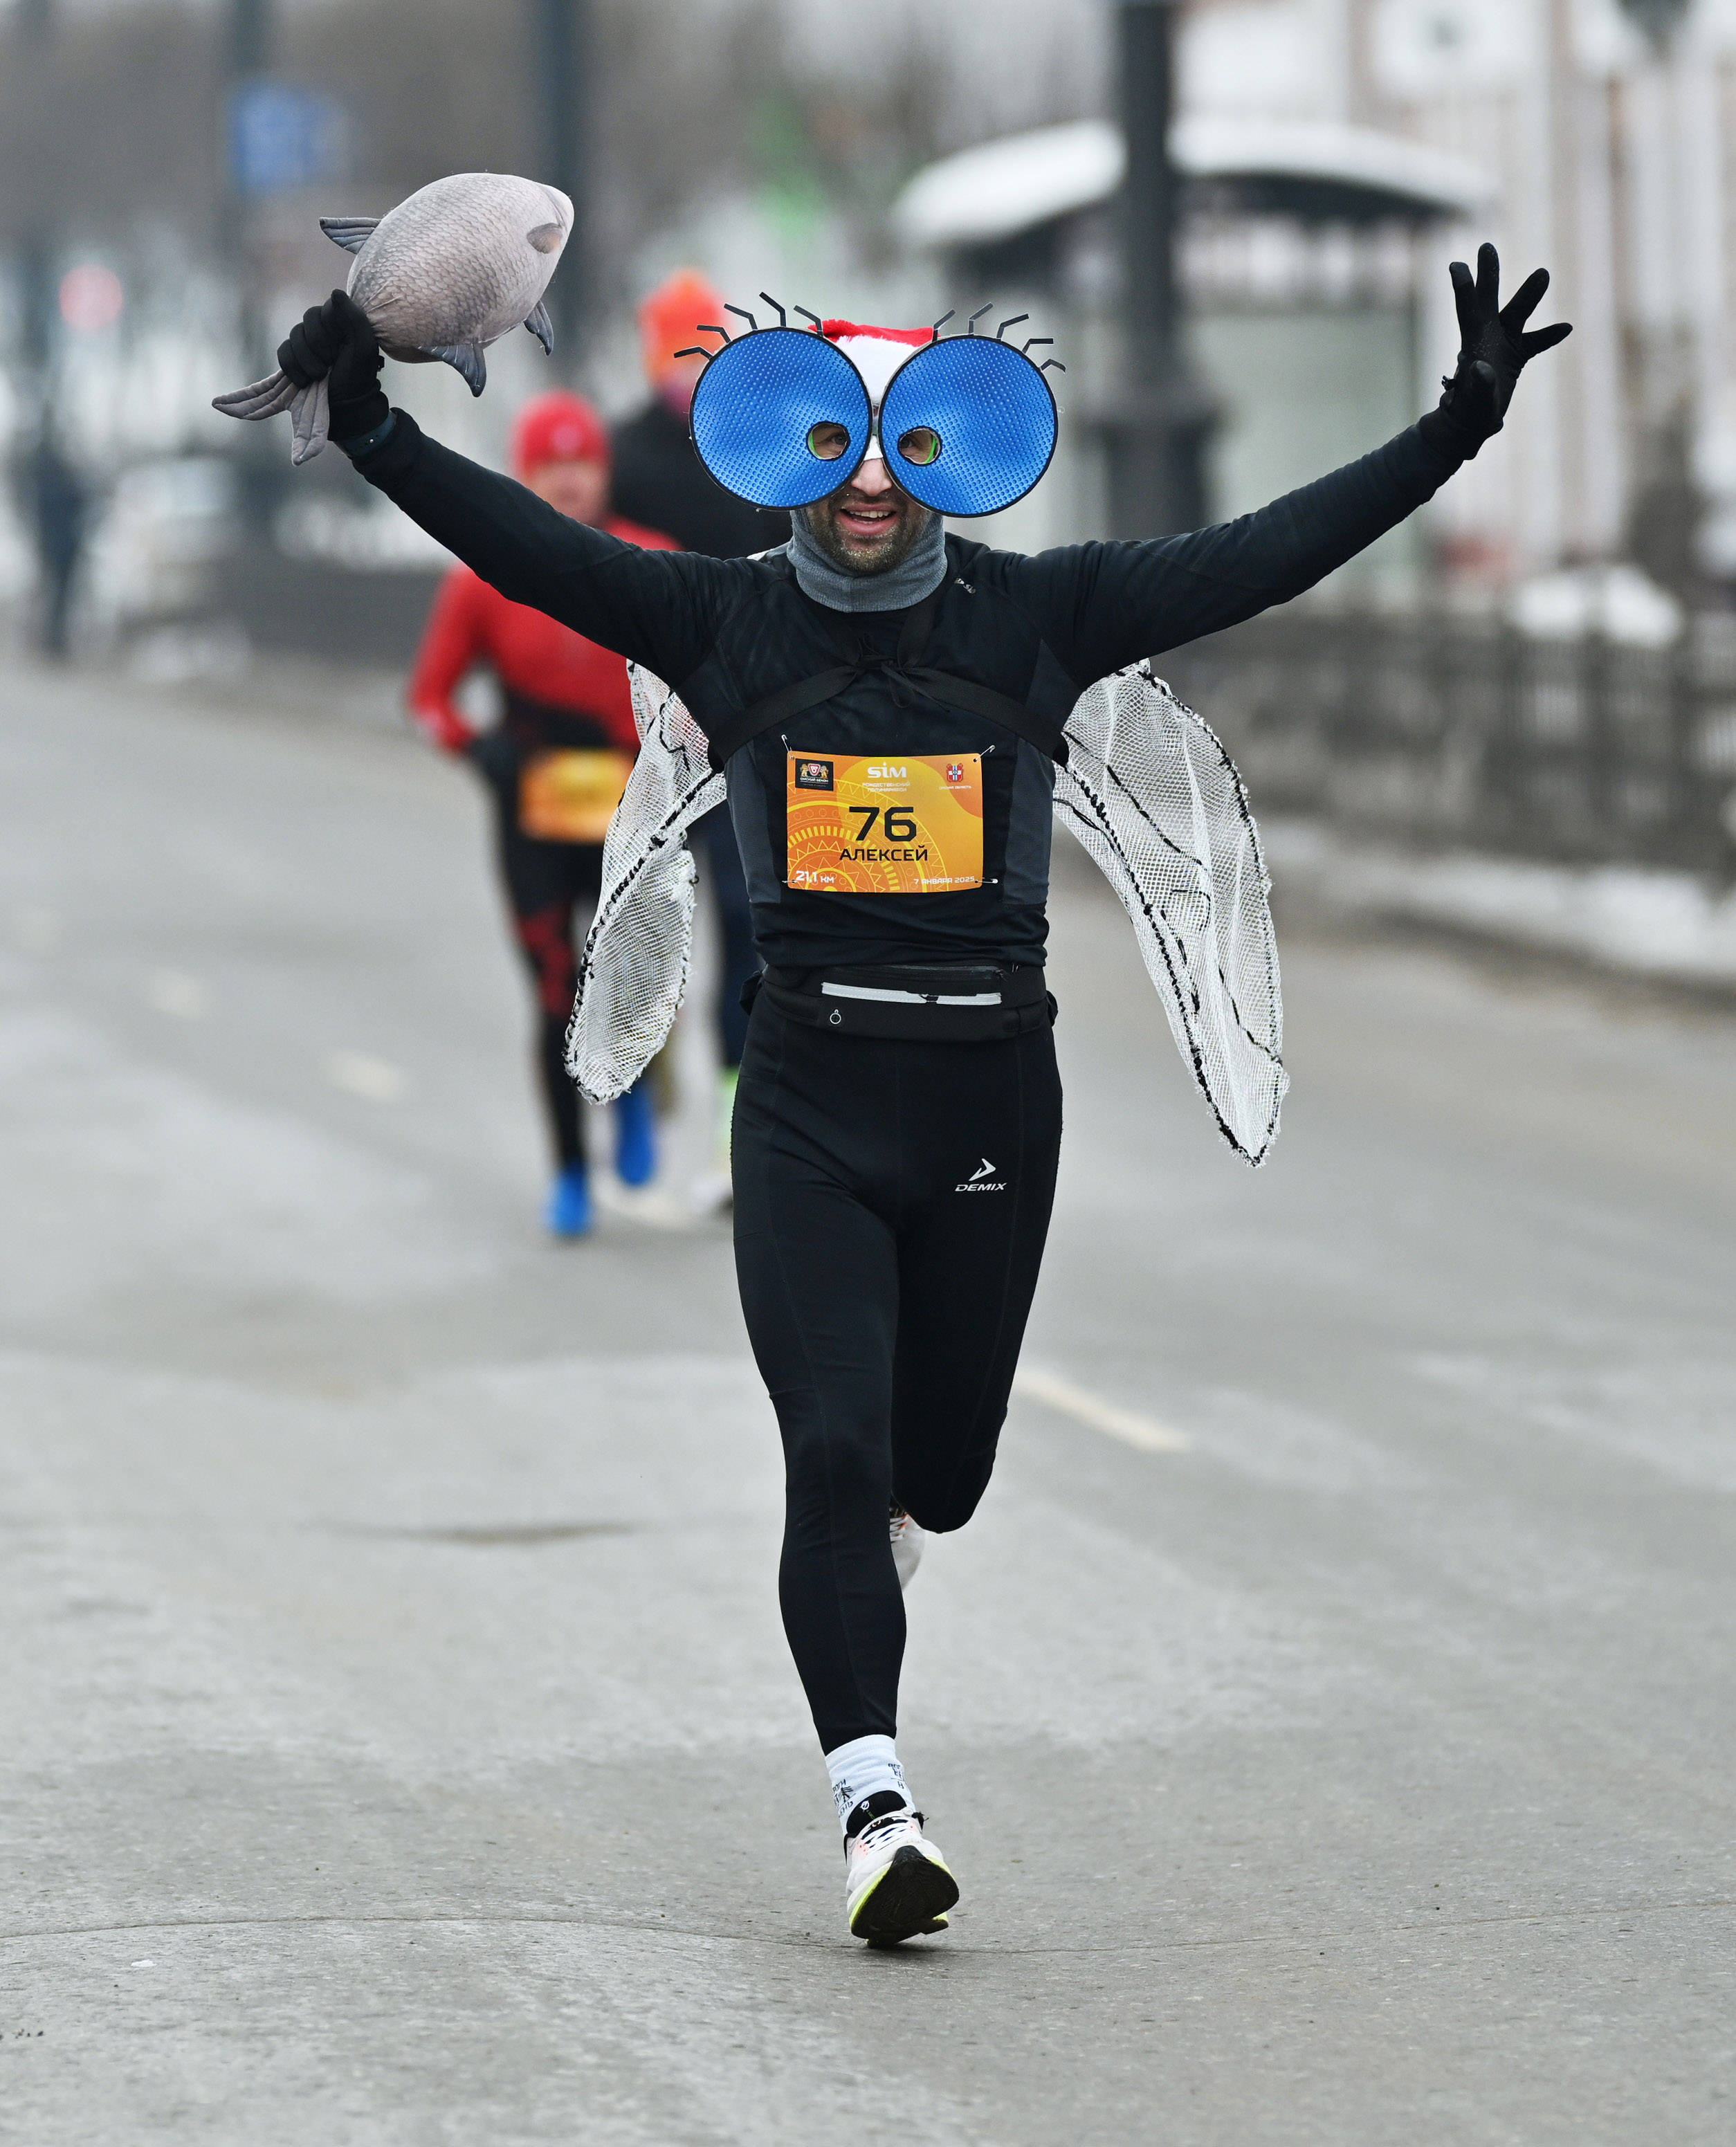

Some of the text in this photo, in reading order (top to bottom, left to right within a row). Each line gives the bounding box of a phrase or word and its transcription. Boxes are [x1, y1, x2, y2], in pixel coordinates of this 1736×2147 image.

[849, 806, 917, 842] 76
[839, 845, 928, 861] АЛЕКСЕЙ
[955, 1182, 1007, 1191] DEMIX
